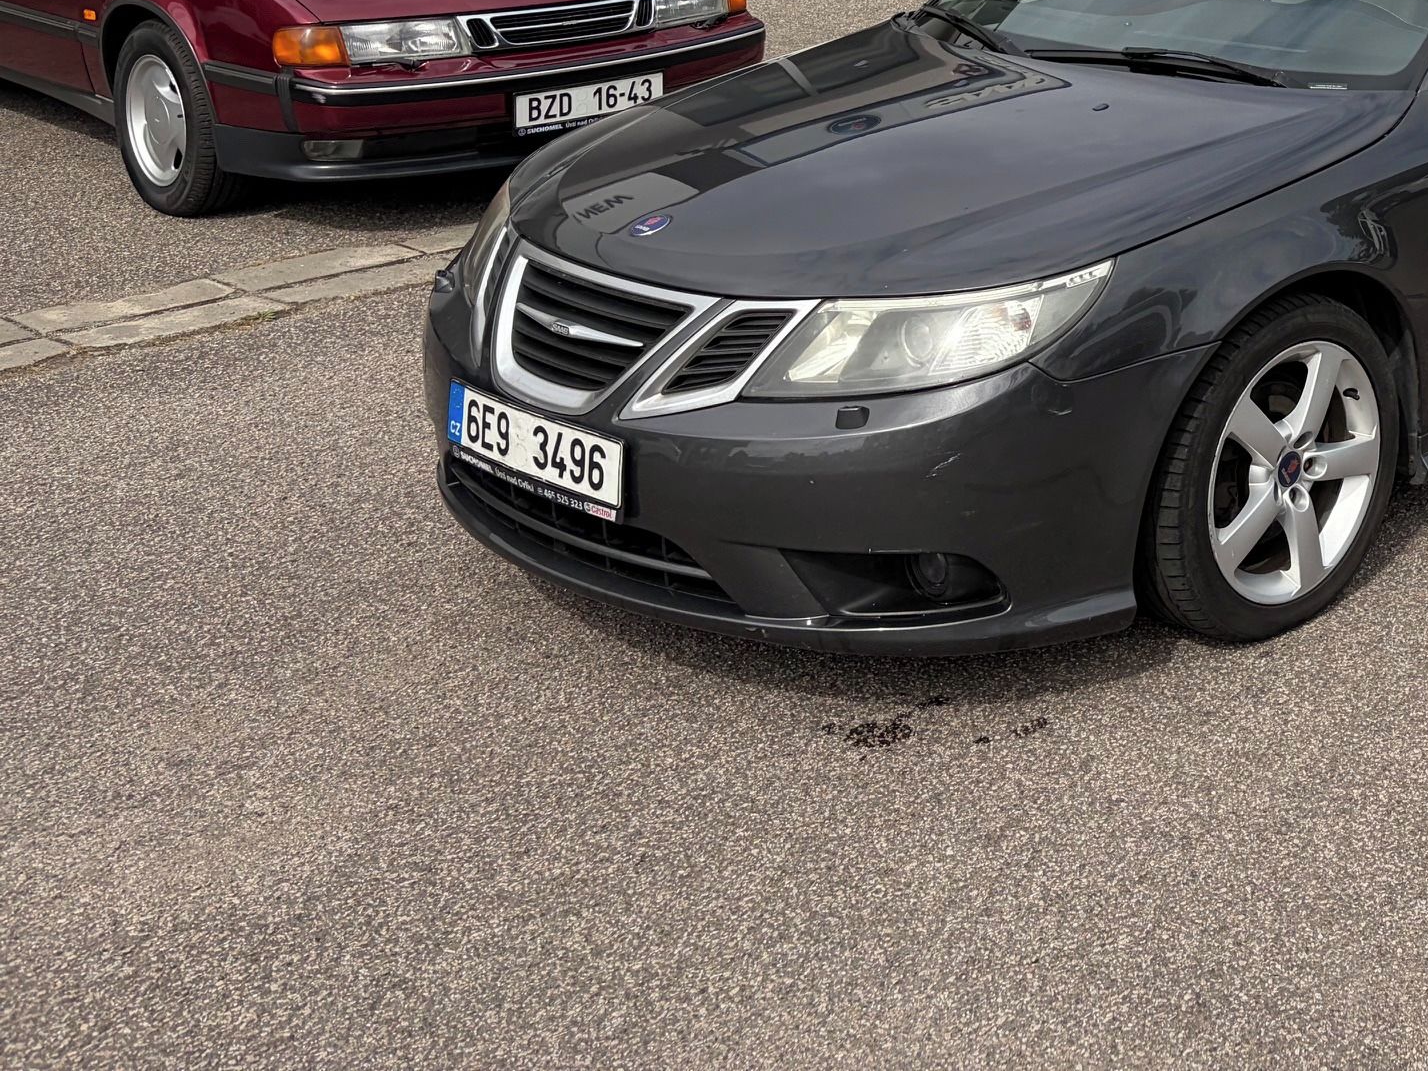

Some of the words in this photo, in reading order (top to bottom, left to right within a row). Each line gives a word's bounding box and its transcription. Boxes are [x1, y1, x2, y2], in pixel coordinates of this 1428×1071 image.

[528, 92, 572, 123] BZD
[593, 78, 652, 111] 16-43
[527, 123, 563, 135] SUCHOMEL
[450, 420, 461, 436] CZ
[467, 399, 510, 458] 6E9
[532, 425, 607, 491] 3496
[556, 493, 569, 505] 525
[570, 498, 583, 510] 323
[591, 505, 613, 519] Castrol
